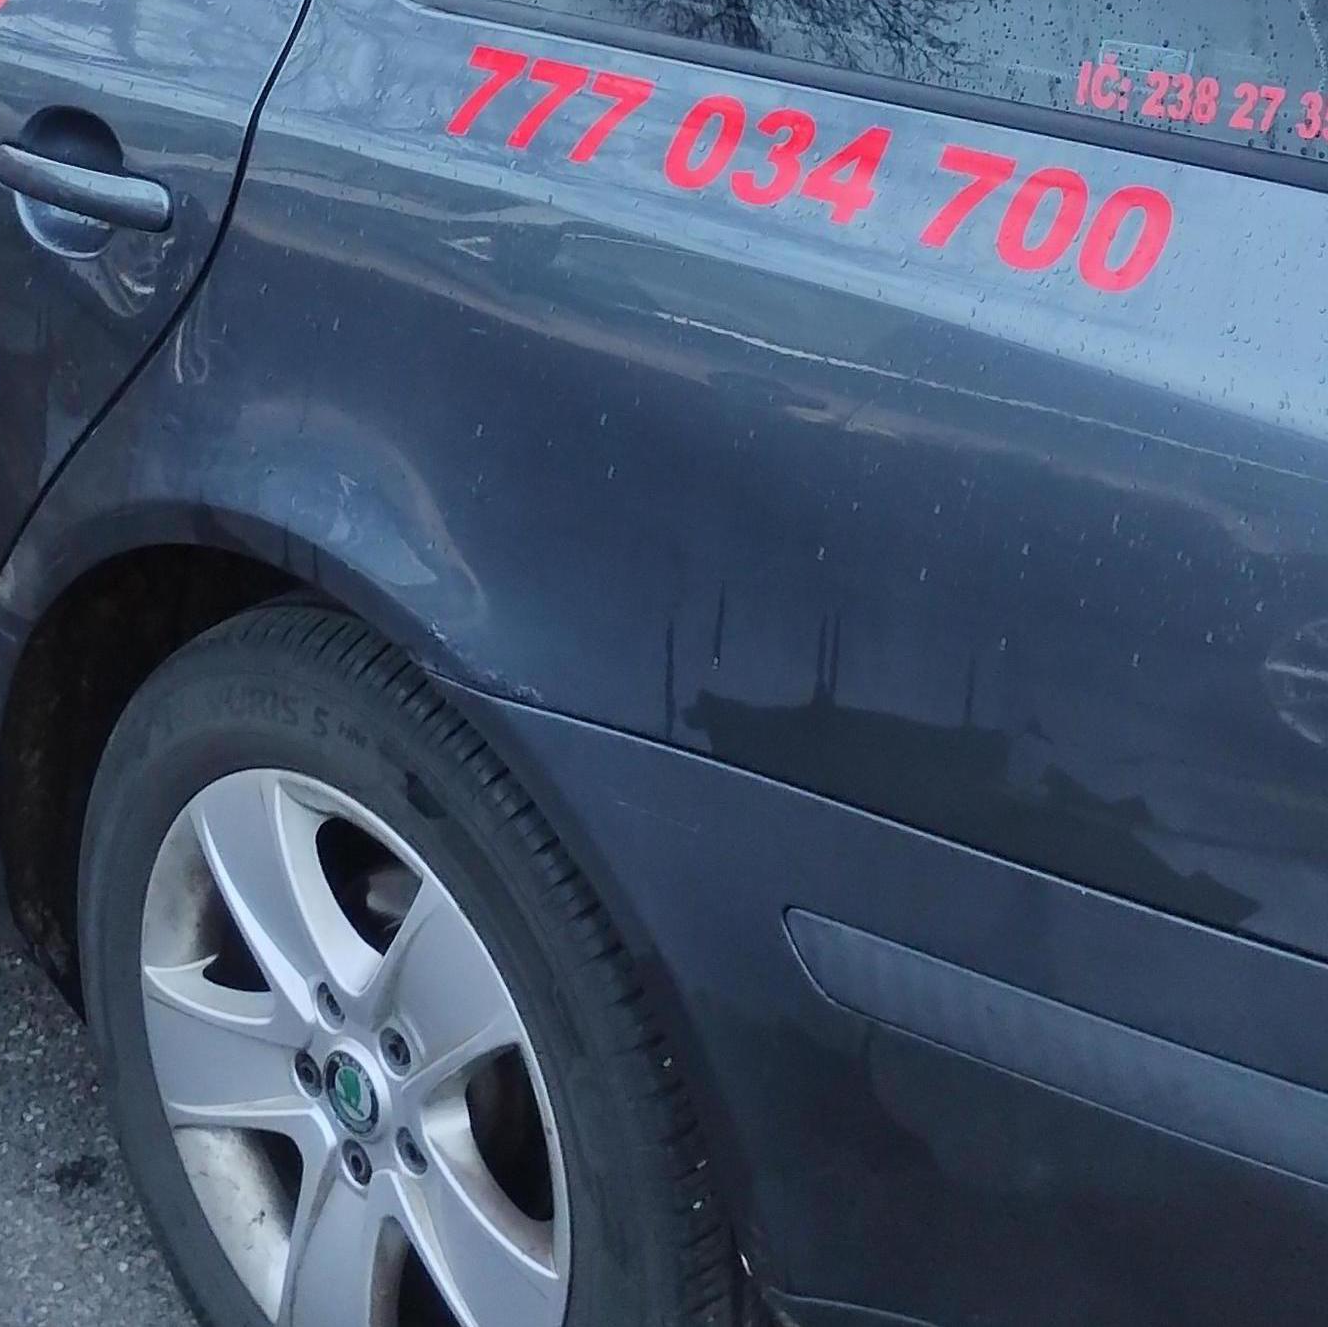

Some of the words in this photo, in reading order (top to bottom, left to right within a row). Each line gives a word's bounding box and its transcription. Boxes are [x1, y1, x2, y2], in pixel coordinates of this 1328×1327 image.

[445, 44, 655, 163] 777
[664, 94, 893, 226] 034
[919, 144, 1174, 294] 700
[1074, 51, 1133, 112] IČ:
[1140, 70, 1220, 124] 238
[1228, 82, 1286, 133] 27
